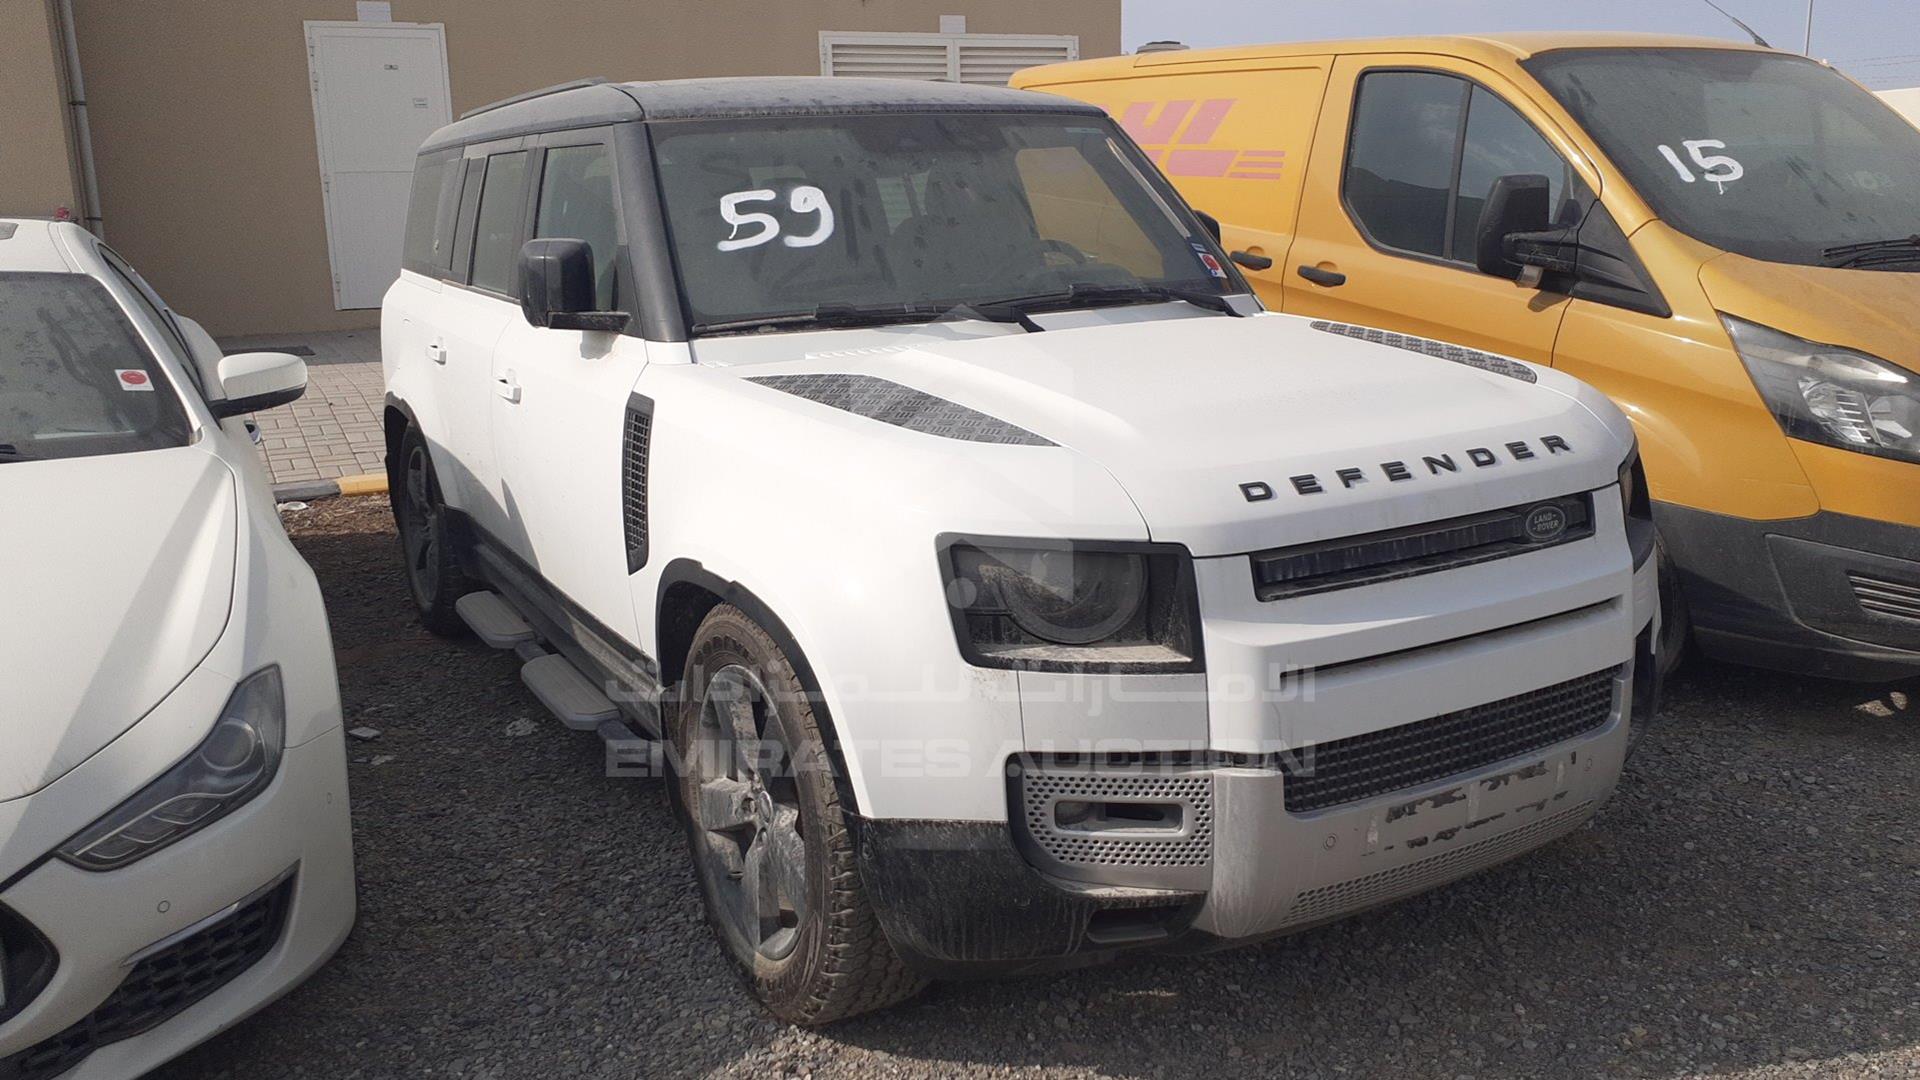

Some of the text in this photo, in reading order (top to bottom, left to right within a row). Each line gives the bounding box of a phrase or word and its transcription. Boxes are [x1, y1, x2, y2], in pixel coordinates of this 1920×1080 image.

[1096, 98, 1238, 177] HL
[1657, 139, 1744, 194] 15
[717, 185, 835, 252] 59
[1238, 434, 1571, 503] DEFENDER
